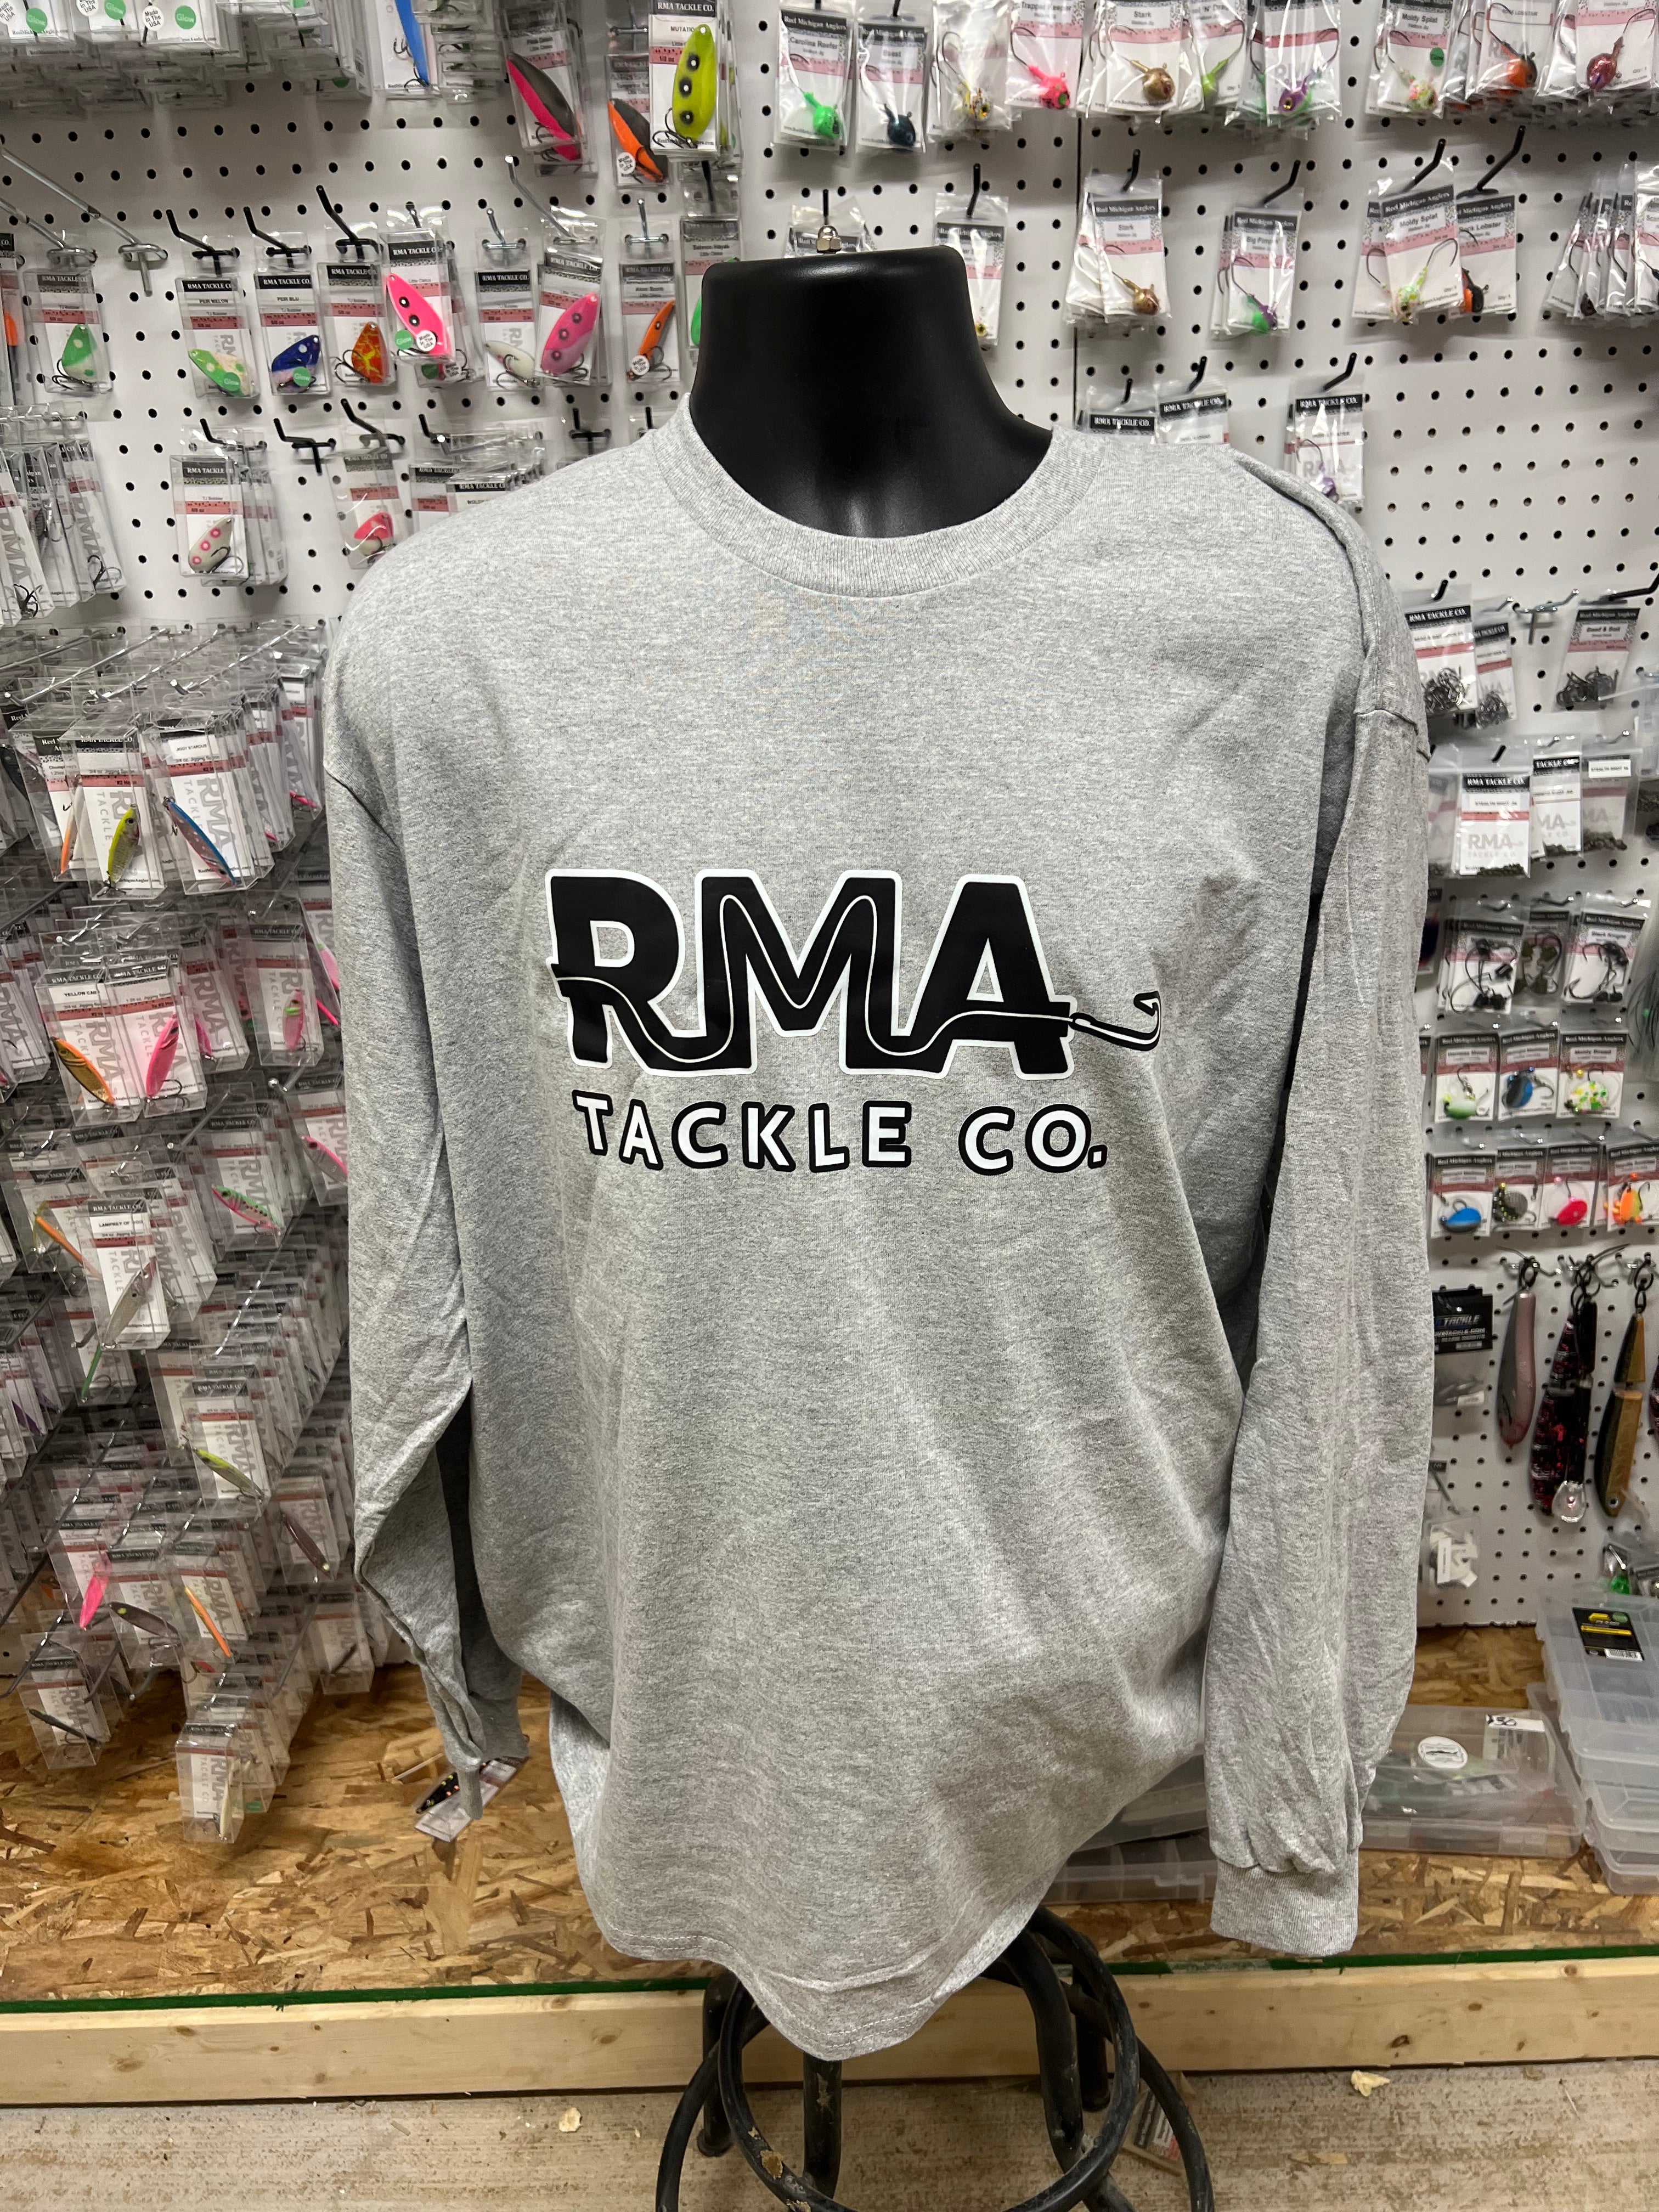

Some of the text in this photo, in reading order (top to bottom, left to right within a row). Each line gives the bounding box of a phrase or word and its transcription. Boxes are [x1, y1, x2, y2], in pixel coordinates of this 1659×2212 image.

[106, 2, 124, 14] Glow
[658, 2, 715, 12] RMA TACKLE CO.
[5, 12, 15, 21] USA
[177, 14, 195, 23] Glow
[1402, 13, 1420, 23] Moldy
[1385, 192, 1450, 213] Reel Michigan Anglers
[1490, 202, 1511, 211] Anglers
[1246, 236, 1256, 245] Big
[1427, 611, 1454, 620] TACKLE
[1536, 760, 1562, 769] TACKLE
[97, 792, 112, 840] TACKLE
[1468, 834, 1513, 849] RMA
[548, 870, 1075, 1079] RMA
[137, 1015, 153, 1057] TACKLE
[572, 1090, 1108, 1176] TACKLE CO.
[109, 1251, 124, 1292] TACKLE
[1443, 1314, 1480, 1327] TACKLE
